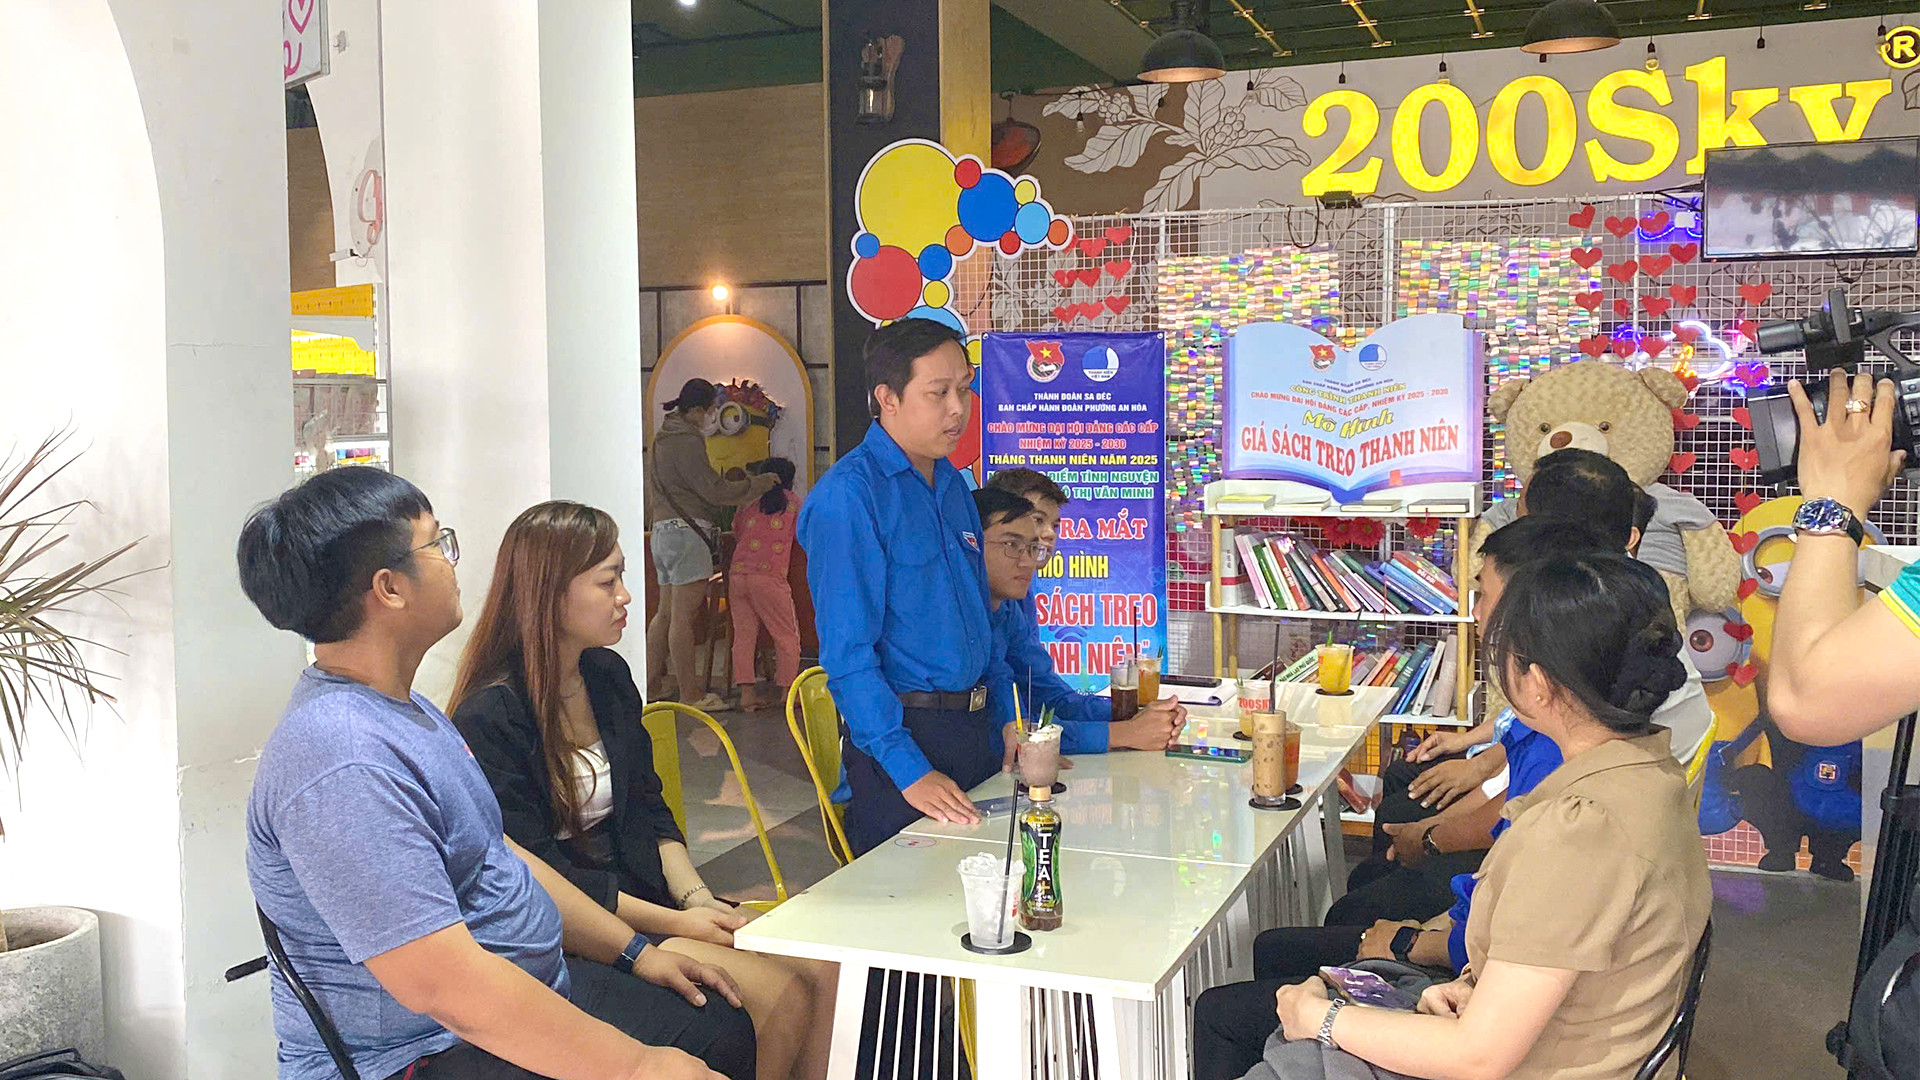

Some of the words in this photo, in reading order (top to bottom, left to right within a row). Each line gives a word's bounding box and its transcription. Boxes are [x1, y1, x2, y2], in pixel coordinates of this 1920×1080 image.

[1034, 391, 1059, 401] THÀNH
[1084, 392, 1095, 401] SA
[1290, 385, 1316, 396] CÔNG
[1348, 387, 1382, 404] THANH
[1407, 390, 1425, 400] 2025
[1431, 388, 1449, 396] 2030
[998, 403, 1015, 412] BAN
[1016, 401, 1037, 412] CHẤP
[1038, 402, 1060, 412] HÀNH
[1084, 402, 1117, 412] PHƯỜNG
[1118, 403, 1130, 412] AN
[987, 420, 1014, 434] CHÀO
[1016, 420, 1046, 434] MỪNG
[1048, 422, 1065, 436] ĐẠI
[1067, 421, 1084, 436] HỘI
[1086, 420, 1114, 434] ĐẢNG
[1115, 421, 1136, 434] CÁC
[1137, 419, 1159, 434] CẤP
[1302, 410, 1337, 433] Mô
[1019, 436, 1052, 450] NHIỆM
[1053, 437, 1067, 450] KỲ
[1068, 438, 1094, 450] 2025
[1101, 438, 1126, 450] 2030
[1241, 420, 1268, 452] GIÁ
[1272, 423, 1312, 462] SÁCH
[1316, 439, 1356, 477] TREO
[1360, 429, 1416, 469] THANH
[1419, 417, 1459, 453] NIÊN
[988, 453, 1025, 465] THÁNG
[1029, 454, 1066, 465] THANH
[1069, 453, 1097, 465] NIÊN
[1100, 453, 1127, 465] NĂM
[1130, 454, 1158, 465] 2025
[1080, 469, 1109, 483] TÌNH
[1110, 469, 1159, 486] NGUYỆN
[1072, 486, 1092, 501] THỊ
[1093, 485, 1119, 499] VĂN
[1120, 487, 1155, 499] MINH
[1059, 517, 1093, 540] RA
[1037, 550, 1064, 579] MÔ
[1068, 550, 1109, 579] HÌNH
[1035, 586, 1095, 627] SÁCH
[1100, 593, 1158, 627] TREO
[1237, 697, 1270, 710] 200SK
